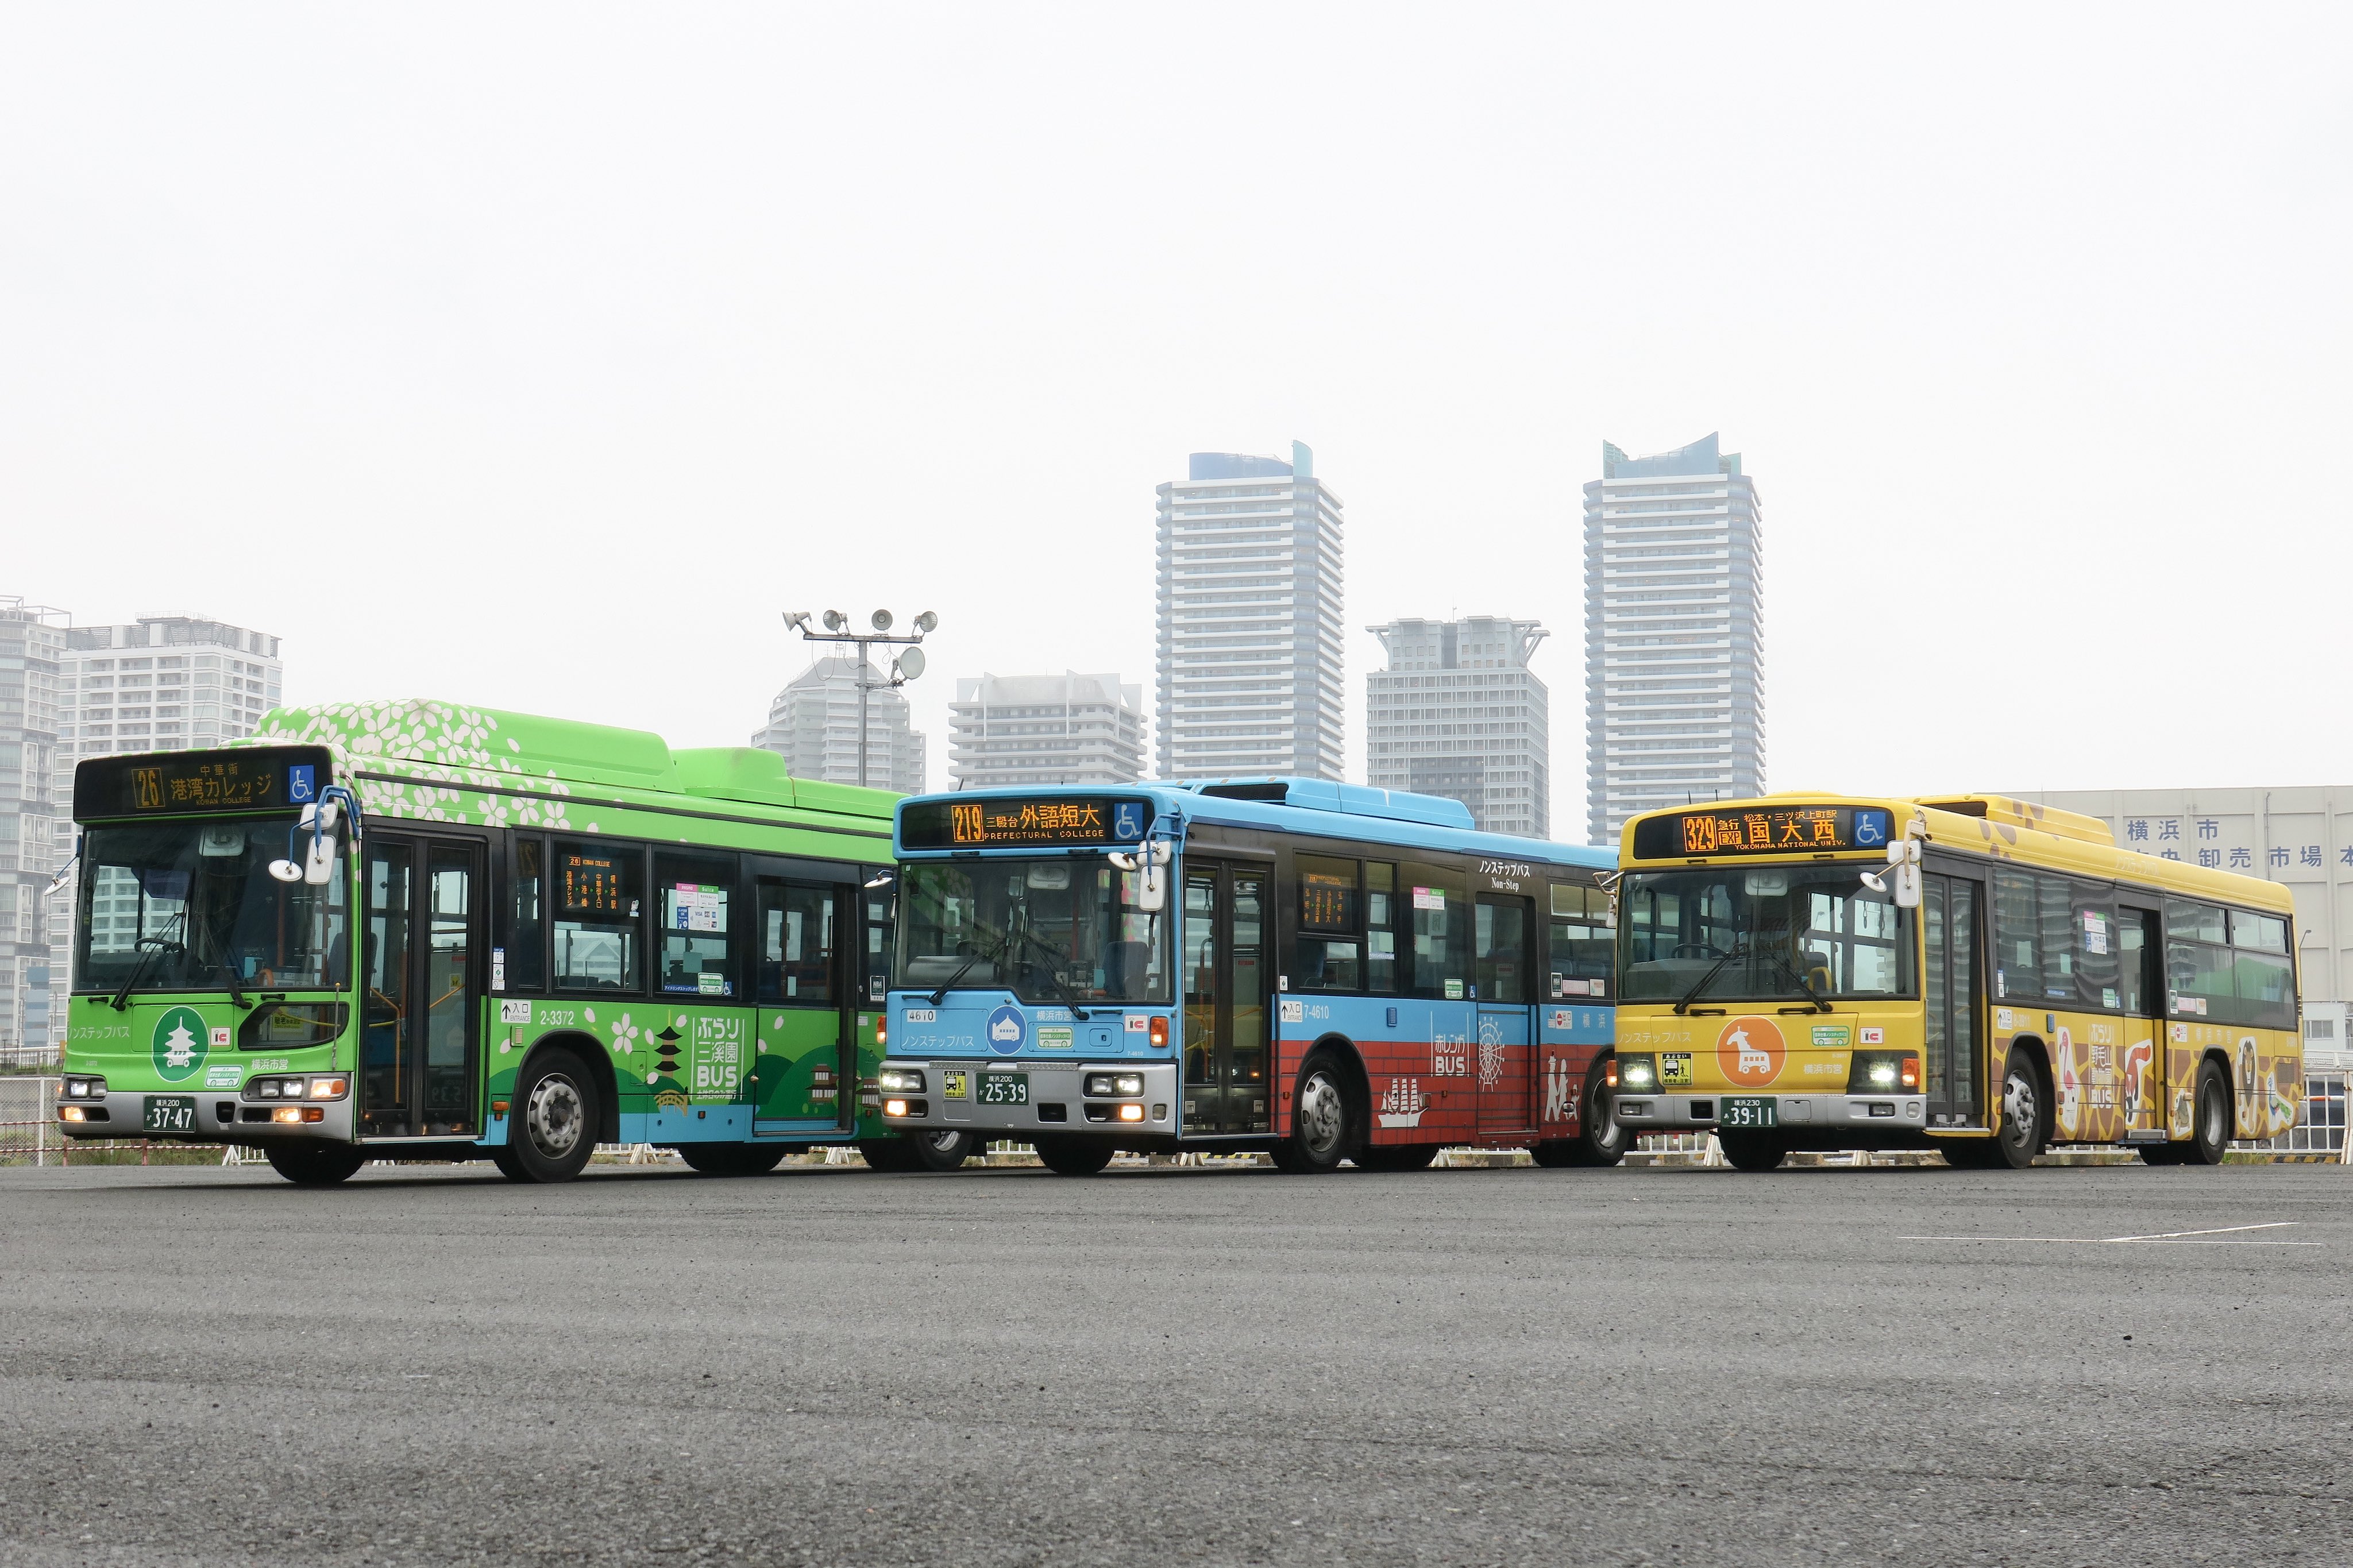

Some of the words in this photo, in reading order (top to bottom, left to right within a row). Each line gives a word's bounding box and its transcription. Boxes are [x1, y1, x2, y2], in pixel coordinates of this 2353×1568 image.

[200, 763, 238, 777] 中華街
[138, 770, 159, 806] 26
[171, 773, 271, 800] 港湾カレッジ
[955, 806, 982, 840] 219
[1020, 804, 1101, 829] 外語短大
[1717, 819, 1739, 831] 急行
[985, 832, 1052, 840] PREFECTURAL
[1687, 817, 1715, 849] 329
[1720, 832, 1741, 844] EXP
[1748, 819, 1835, 844] 国大西
[2127, 819, 2219, 841] 横浜市
[1479, 860, 1530, 877] ノンステップバス
[1491, 877, 1519, 892] Non-Step
[512, 1003, 529, 1013] 入口
[909, 1010, 934, 1021] 4610
[1036, 1010, 1072, 1021] 横浜市営
[1289, 1003, 1301, 1013] 入口
[1304, 1005, 1329, 1019] 7-4610
[540, 1010, 574, 1025] 2-3372
[698, 1017, 739, 1039] ぶらり
[901, 1035, 974, 1047] ノンステップバス
[1435, 1034, 1465, 1053] 赤レンガ
[252, 1059, 288, 1070] 横浜市営
[1435, 1056, 1465, 1076] BUS
[1804, 1064, 1842, 1074] 横浜市営
[697, 1065, 737, 1087] BUS
[985, 1083, 1027, 1102] 25-39
[2091, 1090, 2112, 1109] BUS
[153, 1107, 192, 1128] 37-47
[1730, 1107, 1772, 1125] 39-11
